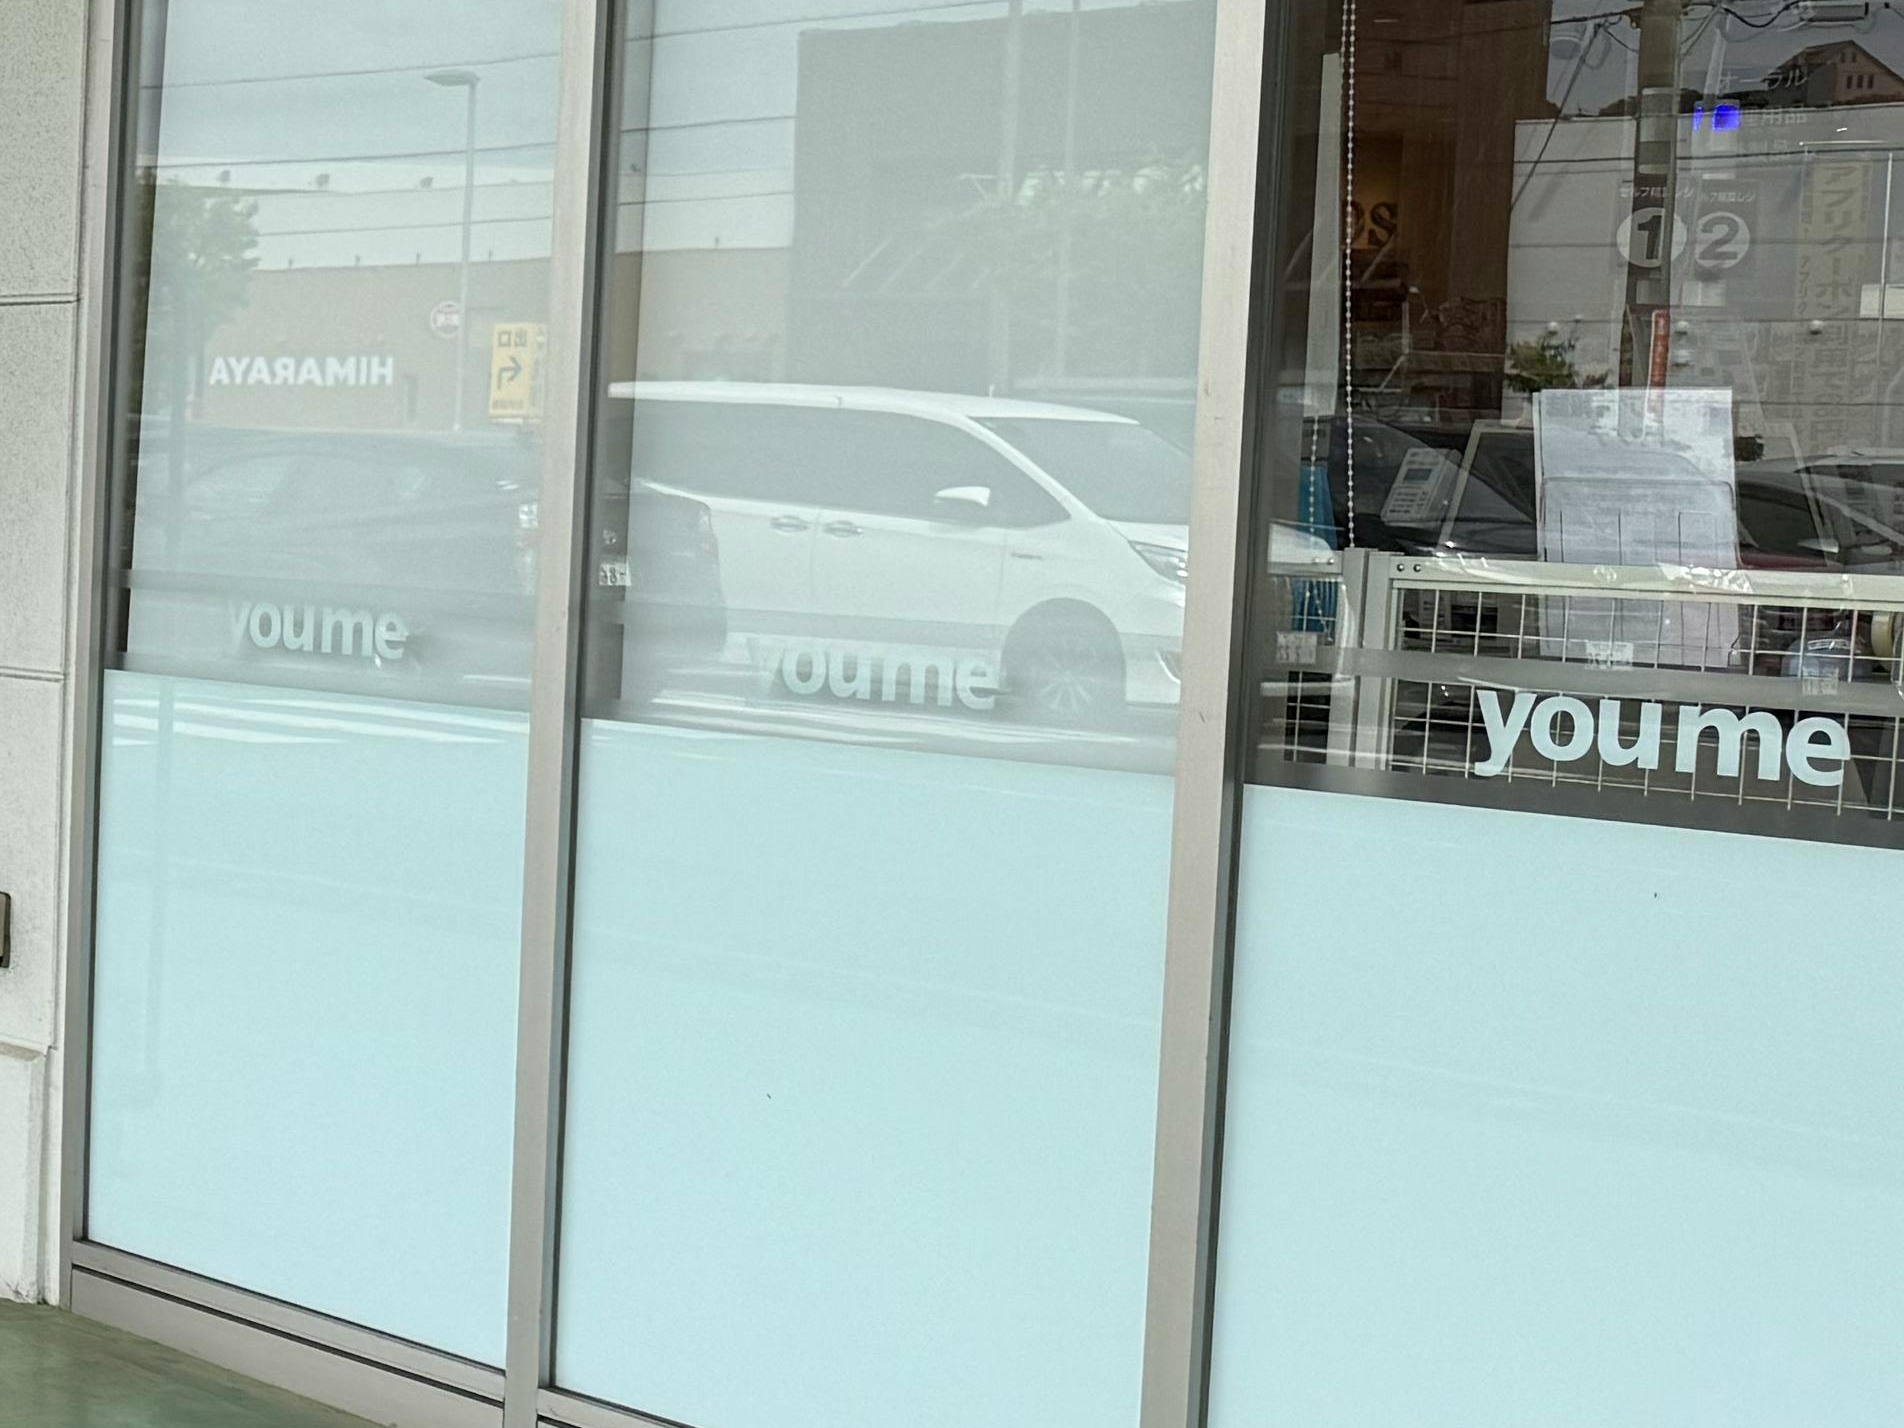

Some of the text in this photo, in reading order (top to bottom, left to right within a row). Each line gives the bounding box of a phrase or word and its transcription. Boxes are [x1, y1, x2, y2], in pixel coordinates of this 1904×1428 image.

[1636, 214, 1663, 260] 1
[1699, 215, 1740, 261] 2
[228, 597, 407, 661] youme
[756, 639, 997, 711] youme
[1474, 688, 1852, 787] youme
